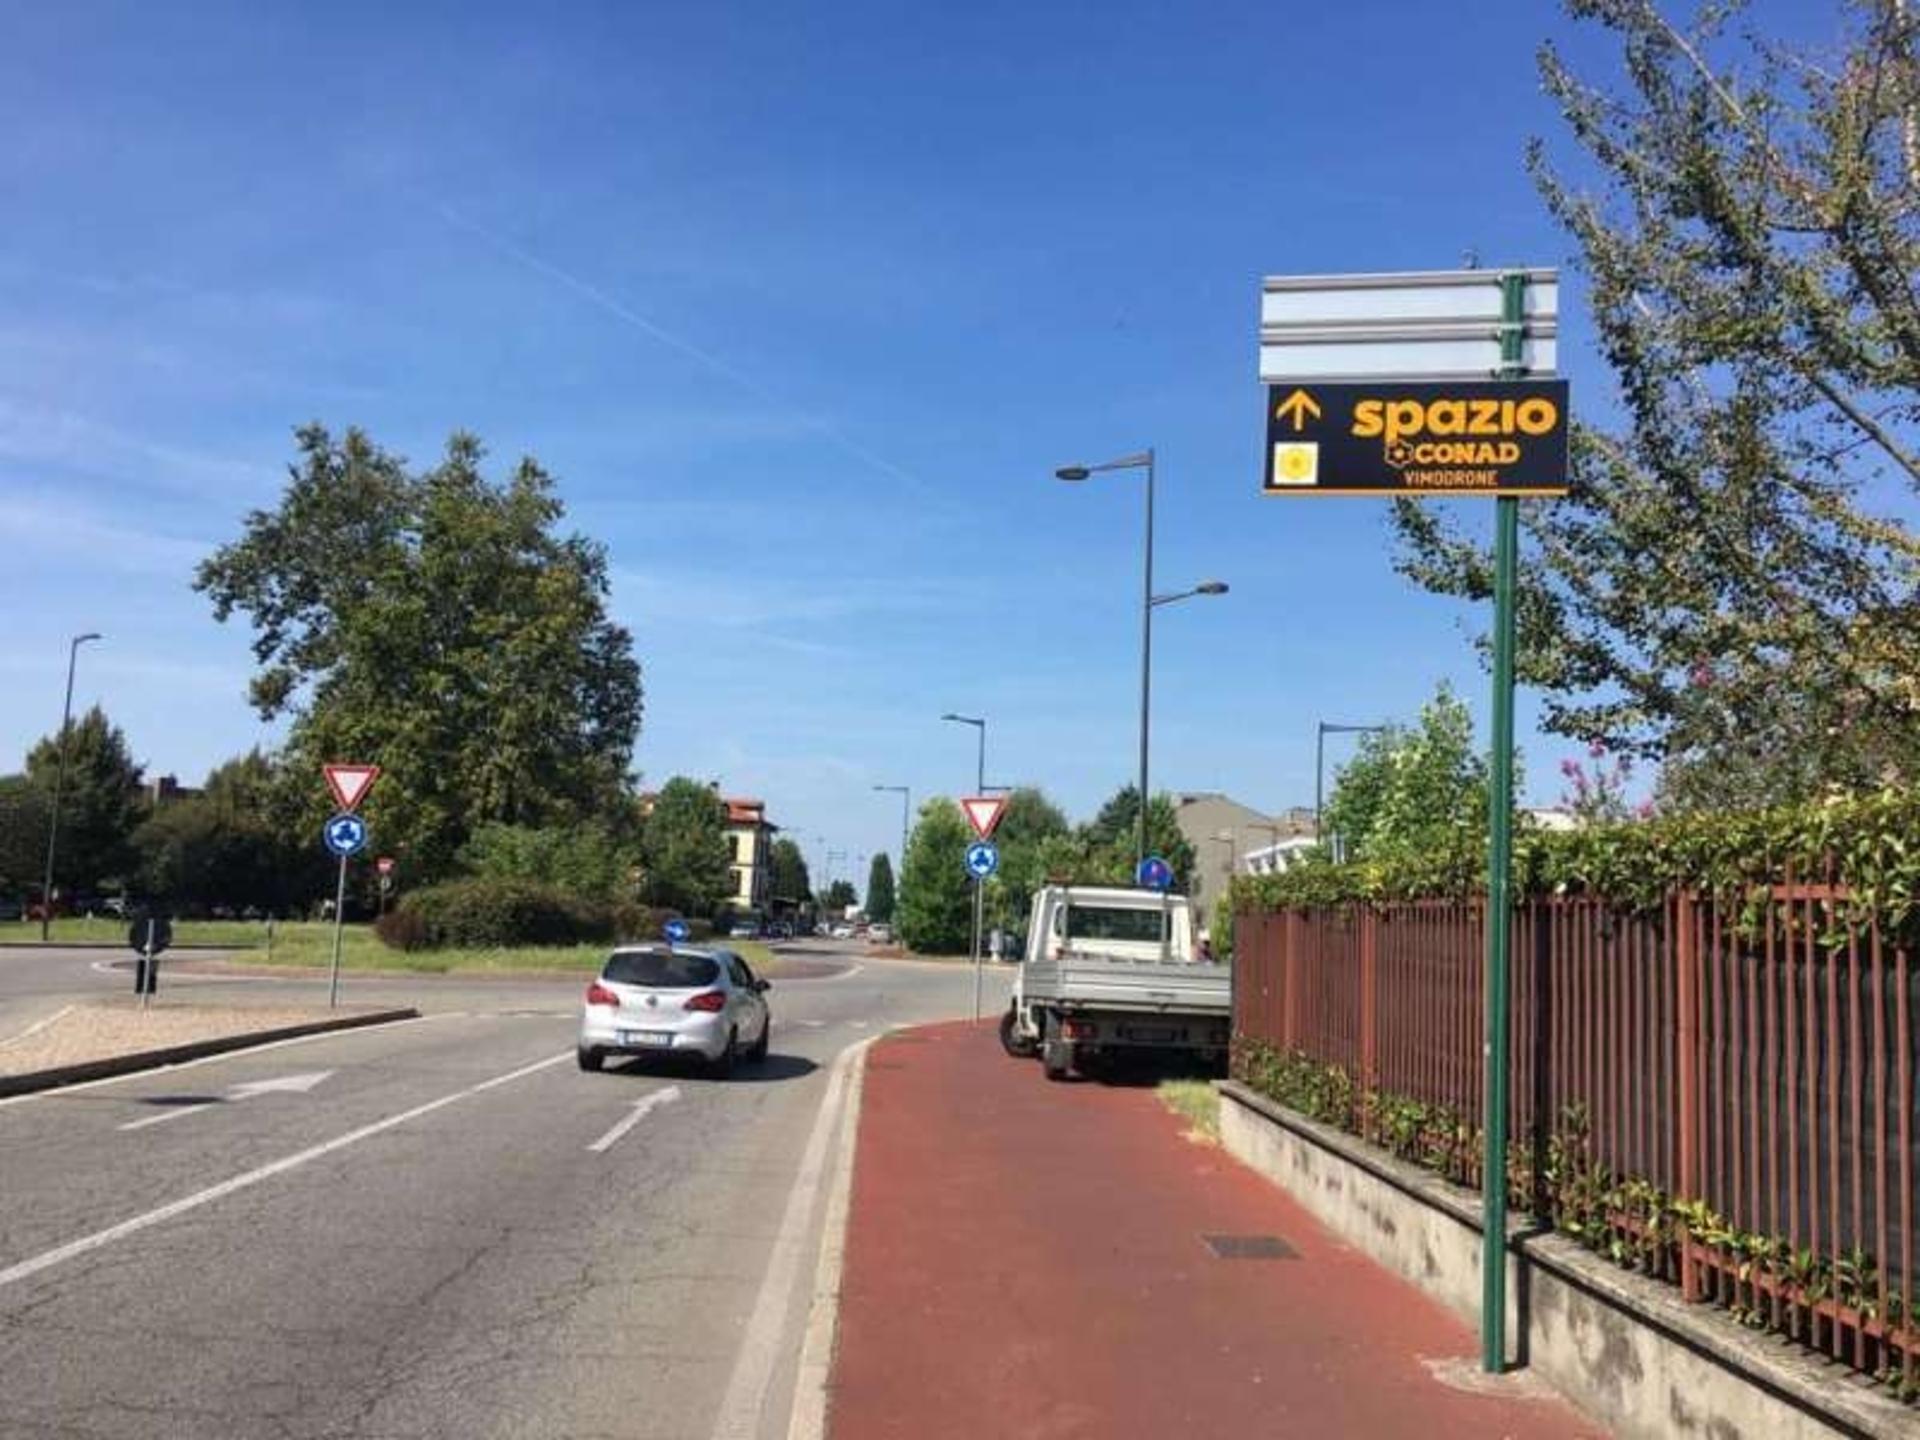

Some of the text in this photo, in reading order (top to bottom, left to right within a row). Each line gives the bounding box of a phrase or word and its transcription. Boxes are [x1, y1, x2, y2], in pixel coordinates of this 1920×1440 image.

[1352, 399, 1557, 443] spazio
[1414, 443, 1521, 464] CONAD
[1404, 470, 1498, 486] VIMODRONE
